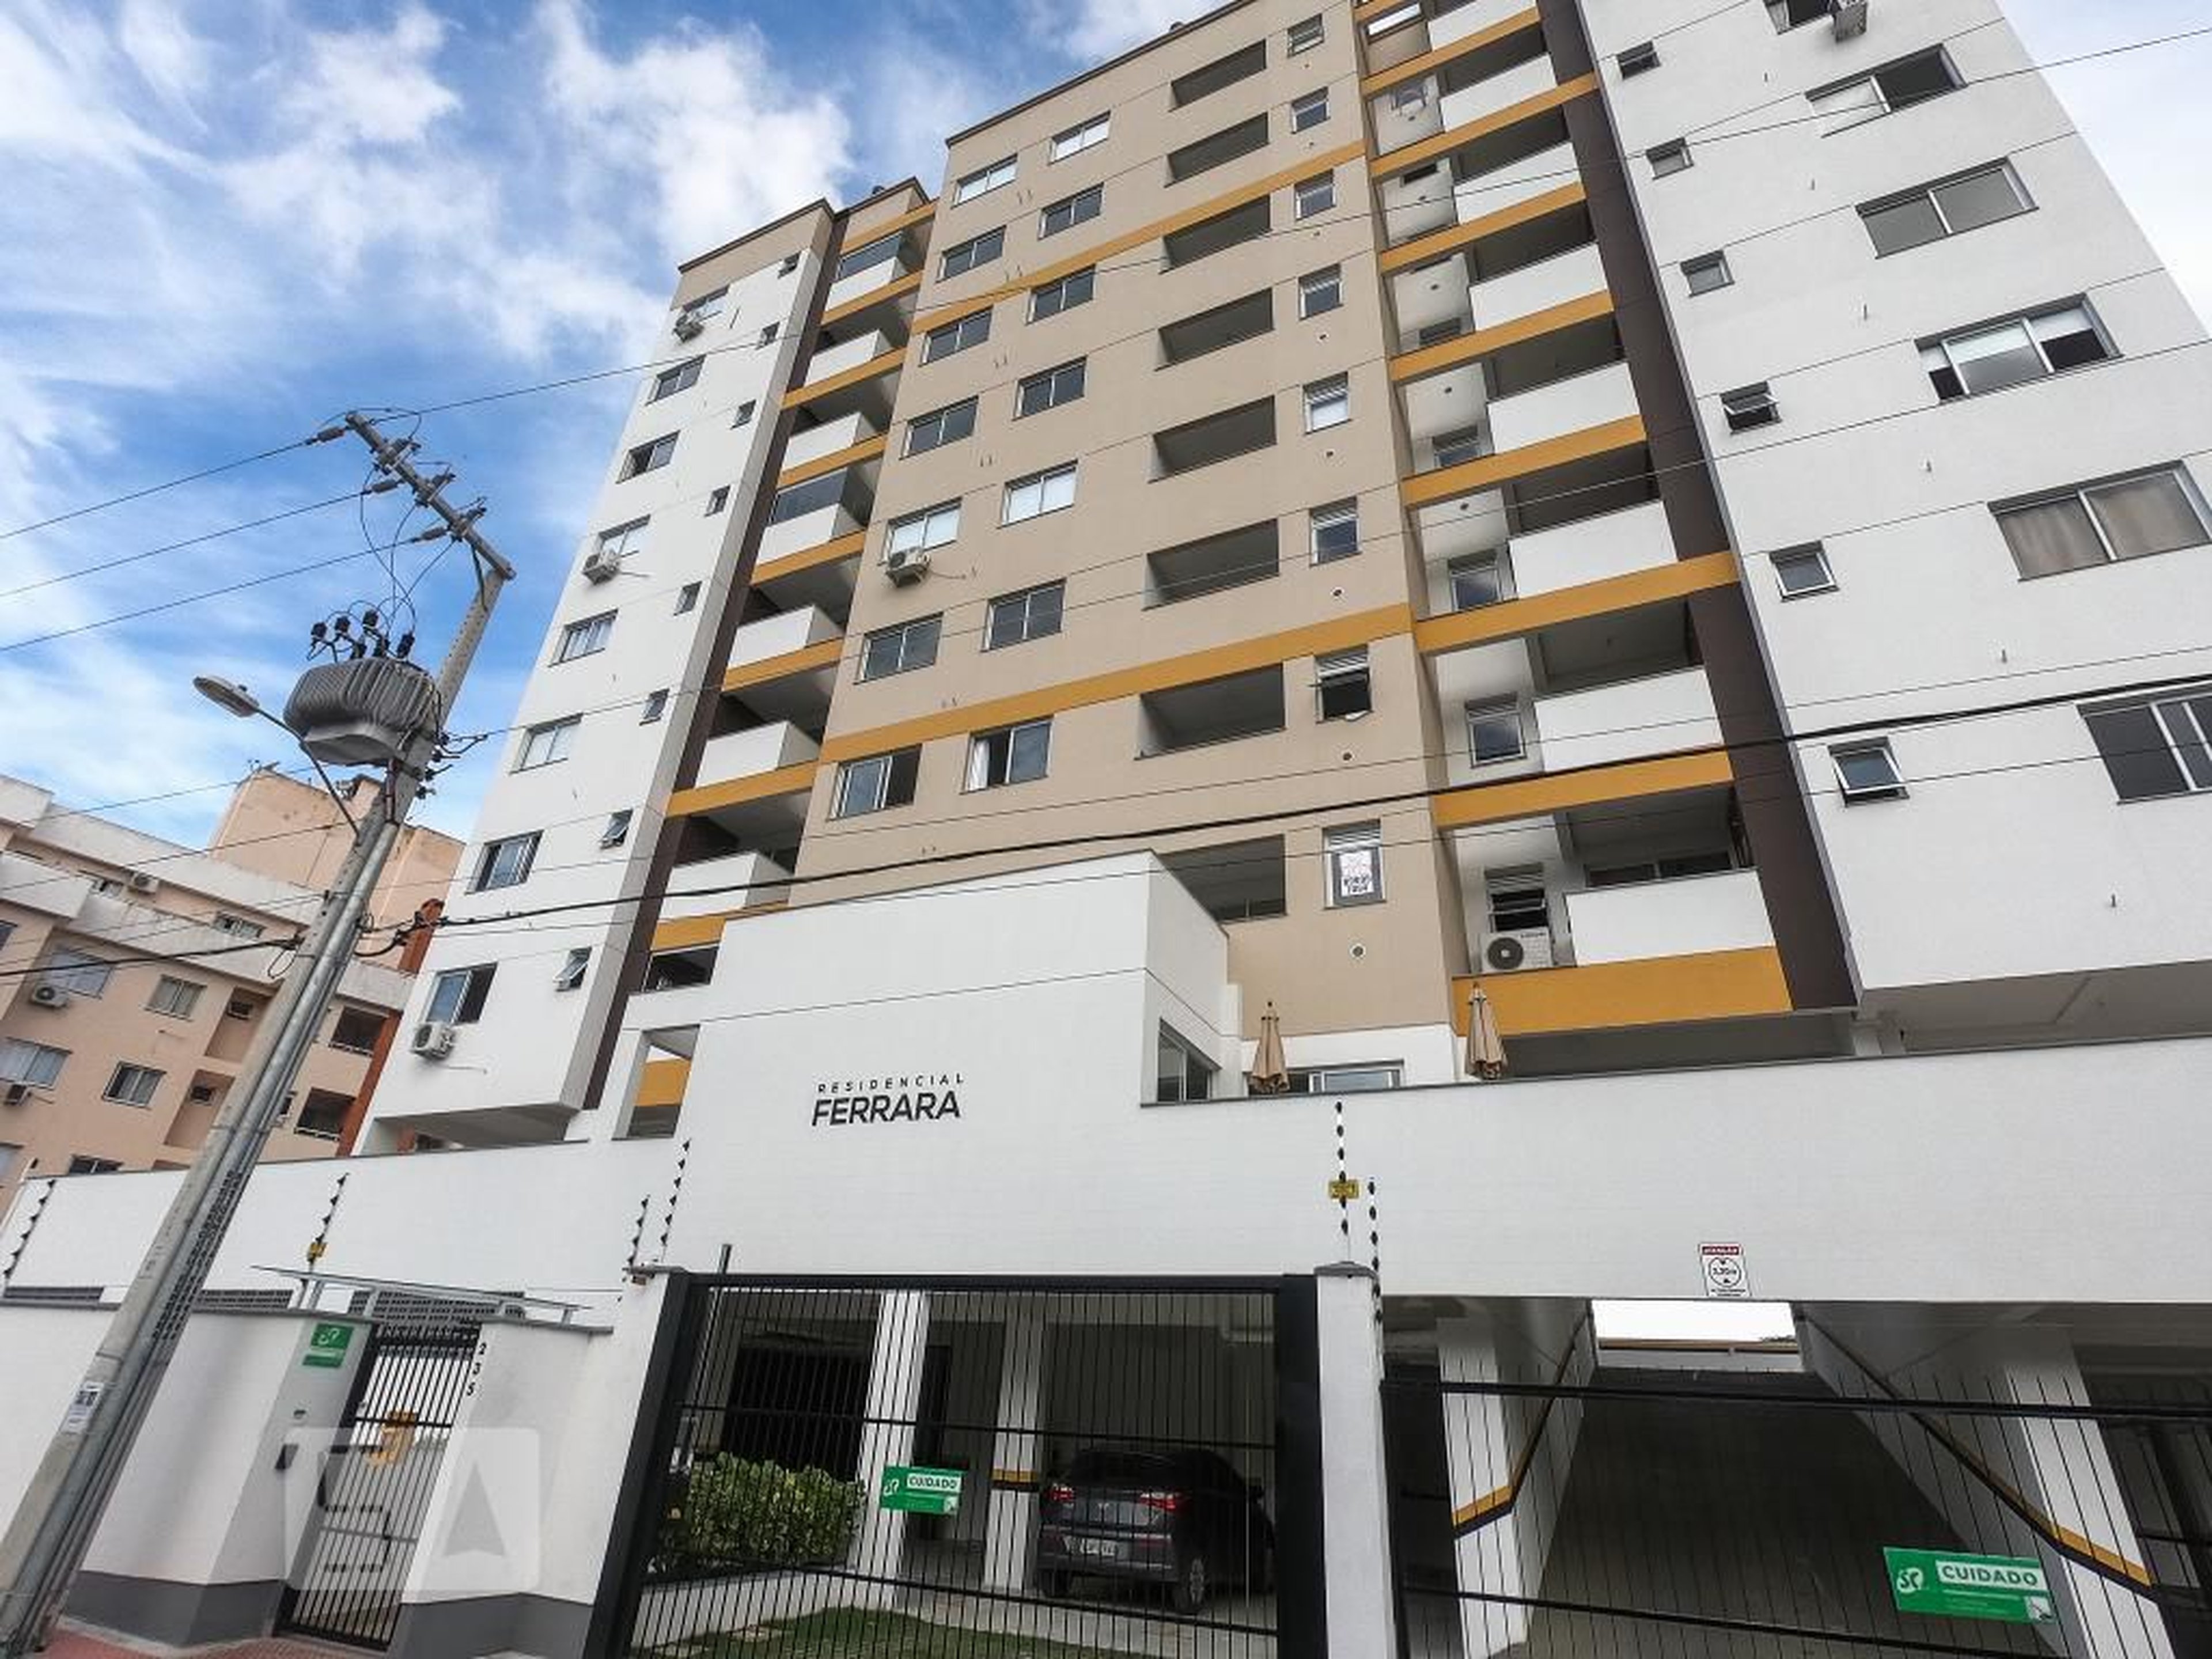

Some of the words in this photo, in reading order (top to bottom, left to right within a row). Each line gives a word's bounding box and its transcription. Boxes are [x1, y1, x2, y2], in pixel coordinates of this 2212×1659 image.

[818, 1073, 963, 1093] RESIDENCIAL
[812, 1090, 960, 1126] FERRARA
[1941, 1565, 2038, 1586] CUIDADO
